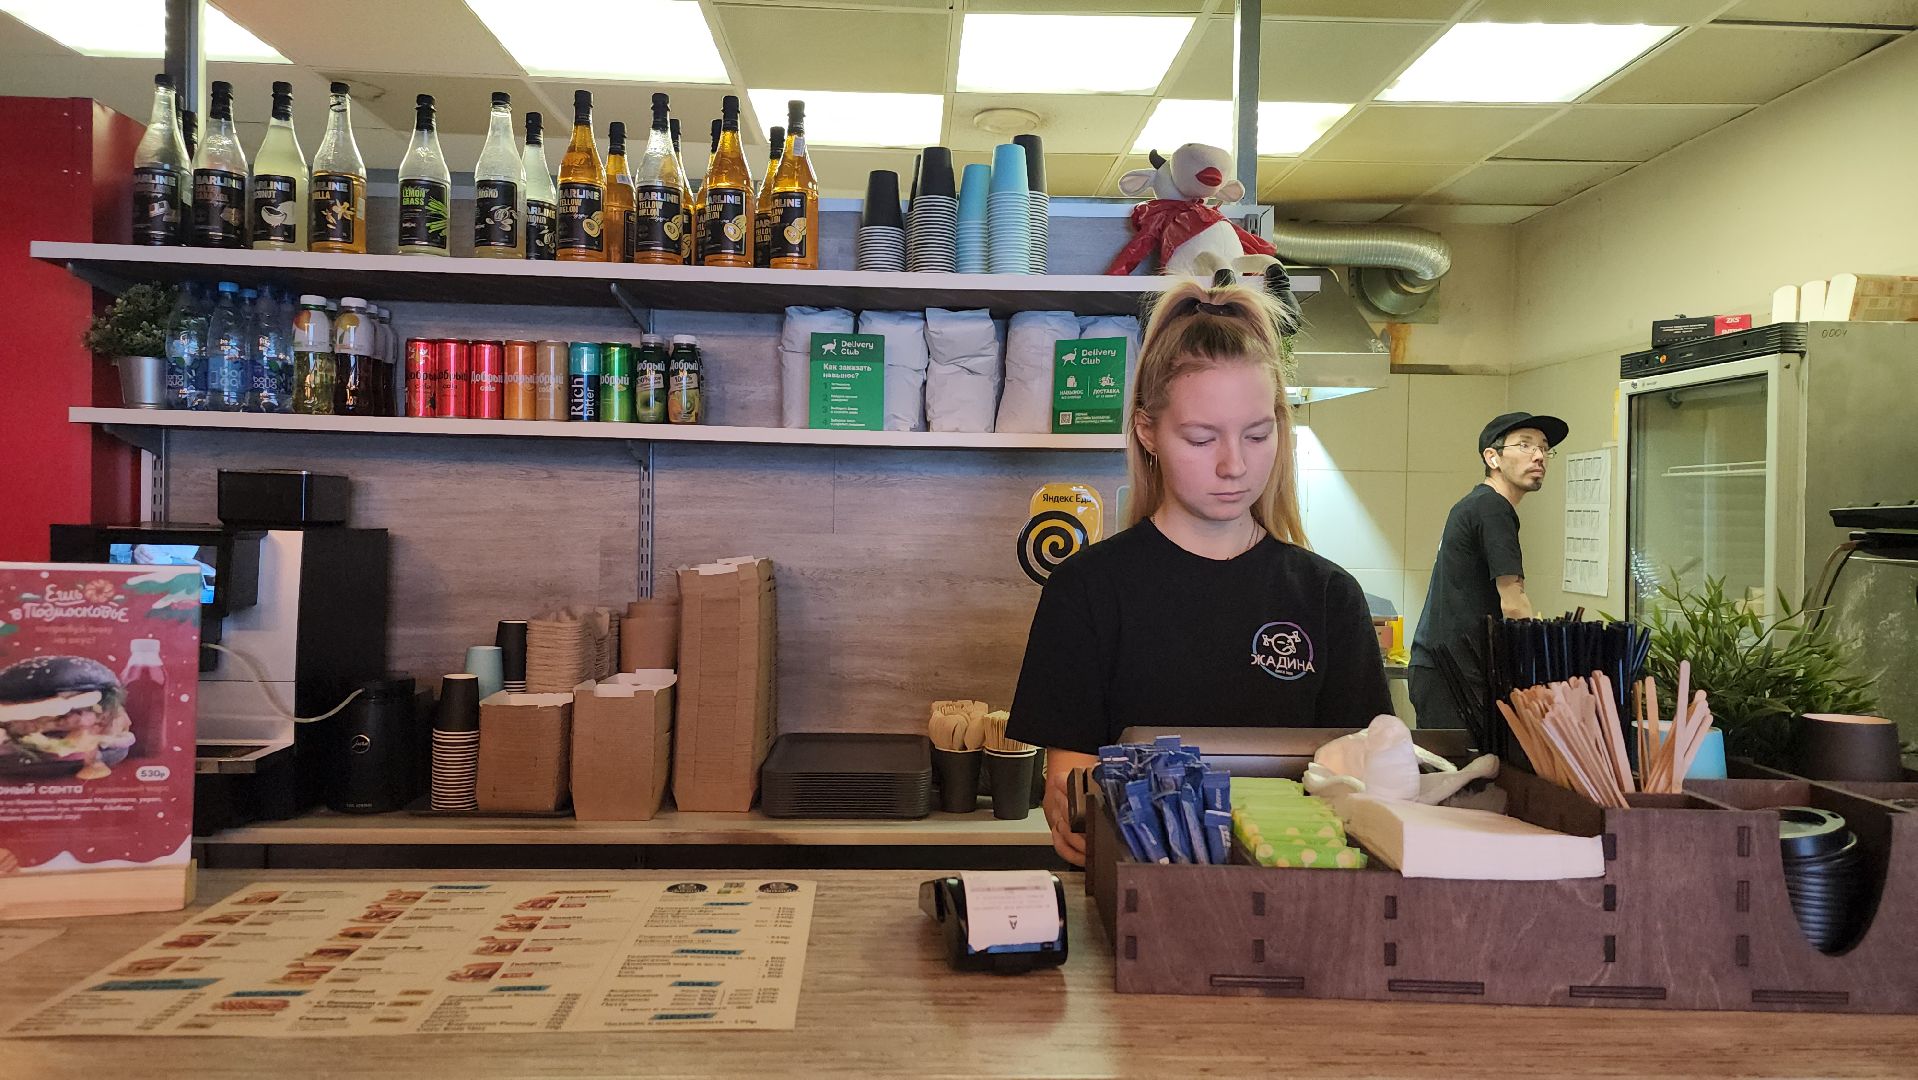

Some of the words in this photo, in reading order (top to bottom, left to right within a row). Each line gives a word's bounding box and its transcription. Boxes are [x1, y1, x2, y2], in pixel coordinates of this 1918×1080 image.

[402, 188, 426, 198] LEMON
[402, 197, 425, 206] GRASS
[639, 201, 663, 209] YELLOW
[708, 195, 741, 205] ARLINE
[639, 208, 660, 216] MELON
[841, 340, 874, 350] Delivery
[1081, 348, 1117, 357] Delivery
[670, 359, 699, 371] Добрый
[1080, 357, 1101, 365] Club
[823, 363, 837, 371] Как
[571, 377, 584, 416] Rich
[1042, 494, 1073, 503] Яндекс
[45, 584, 84, 603] Ешь
[22, 602, 129, 622] Подмосковье
[1250, 653, 1315, 673] ЖАДИНА
[140, 769, 166, 779] 530р
[38, 785, 83, 794] санта
